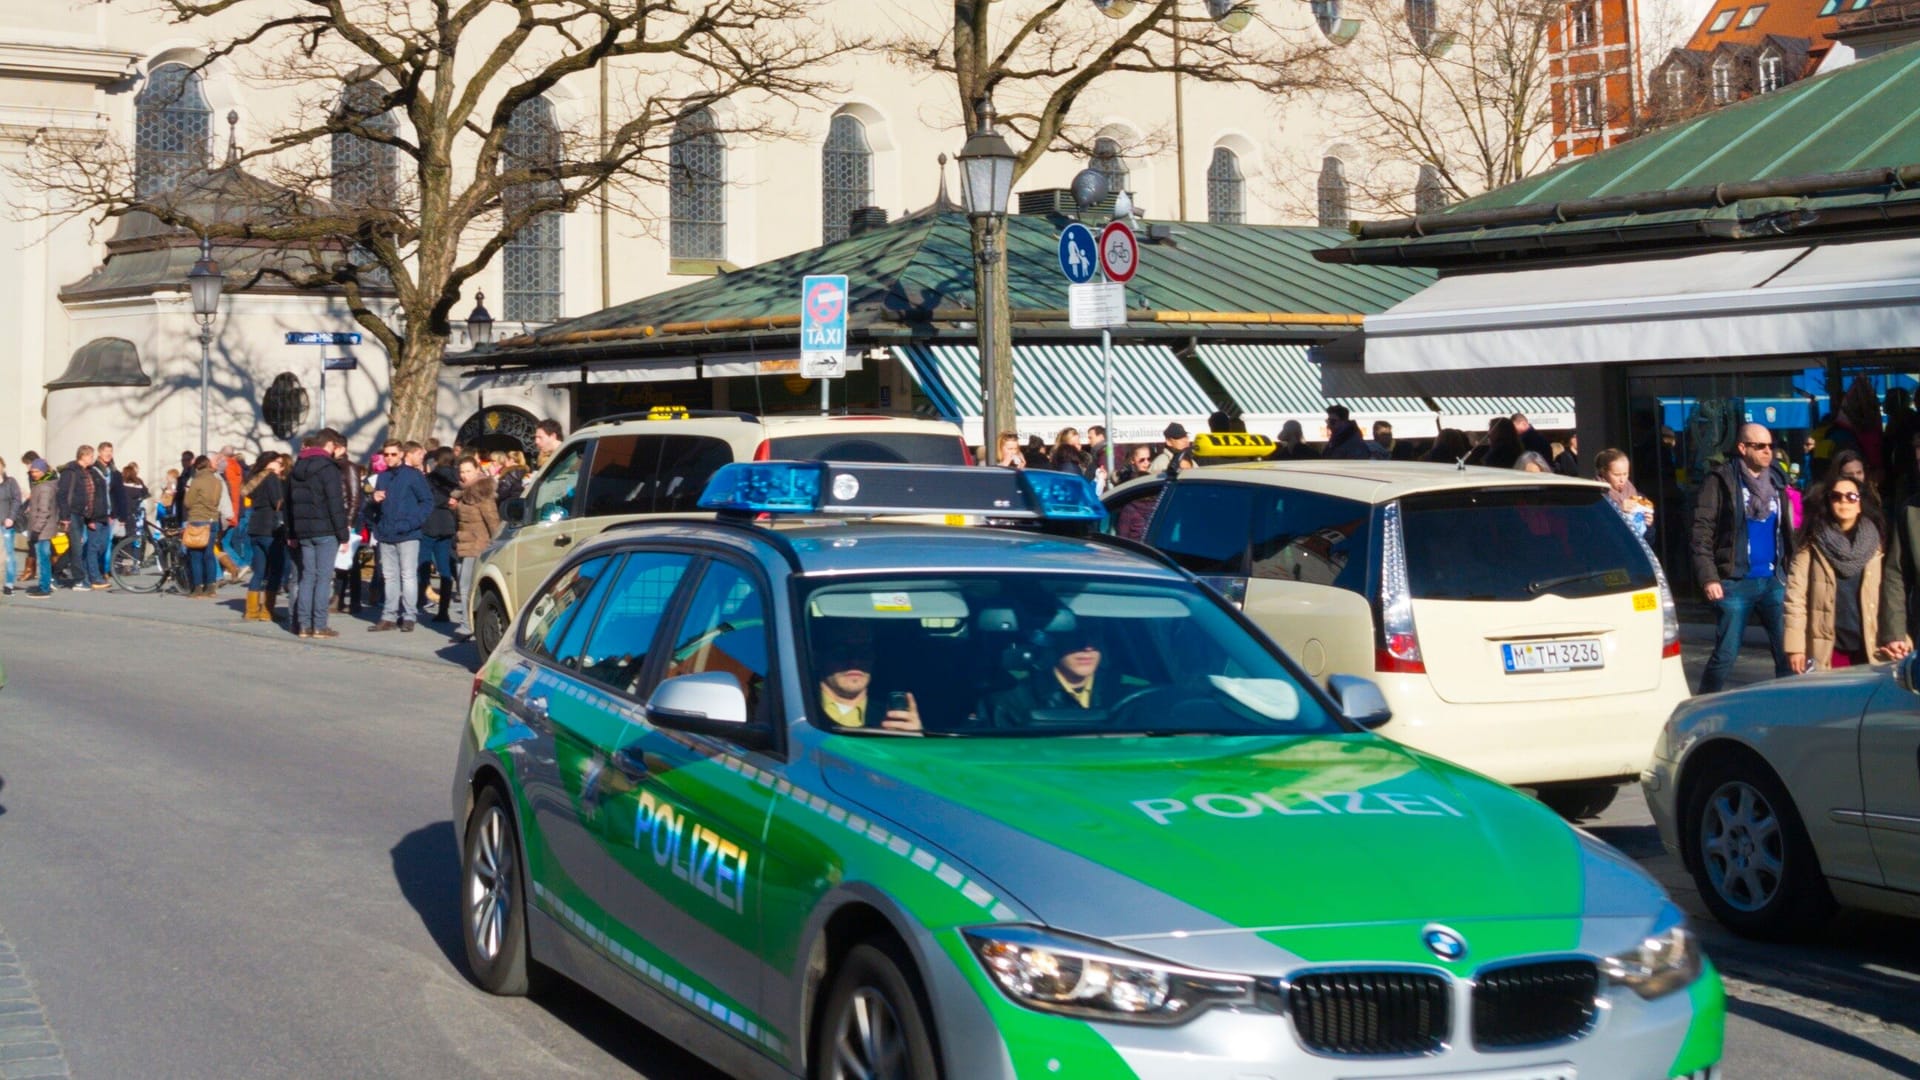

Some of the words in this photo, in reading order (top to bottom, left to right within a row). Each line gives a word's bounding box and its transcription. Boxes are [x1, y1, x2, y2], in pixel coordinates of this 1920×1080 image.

[806, 328, 842, 345] TAXI
[1211, 434, 1267, 446] TAXI
[1513, 647, 1526, 666] M
[1536, 645, 1559, 665] TH
[1561, 643, 1600, 663] 3236
[1131, 791, 1464, 825] POLIZEI
[634, 789, 748, 915] POLIZEI
